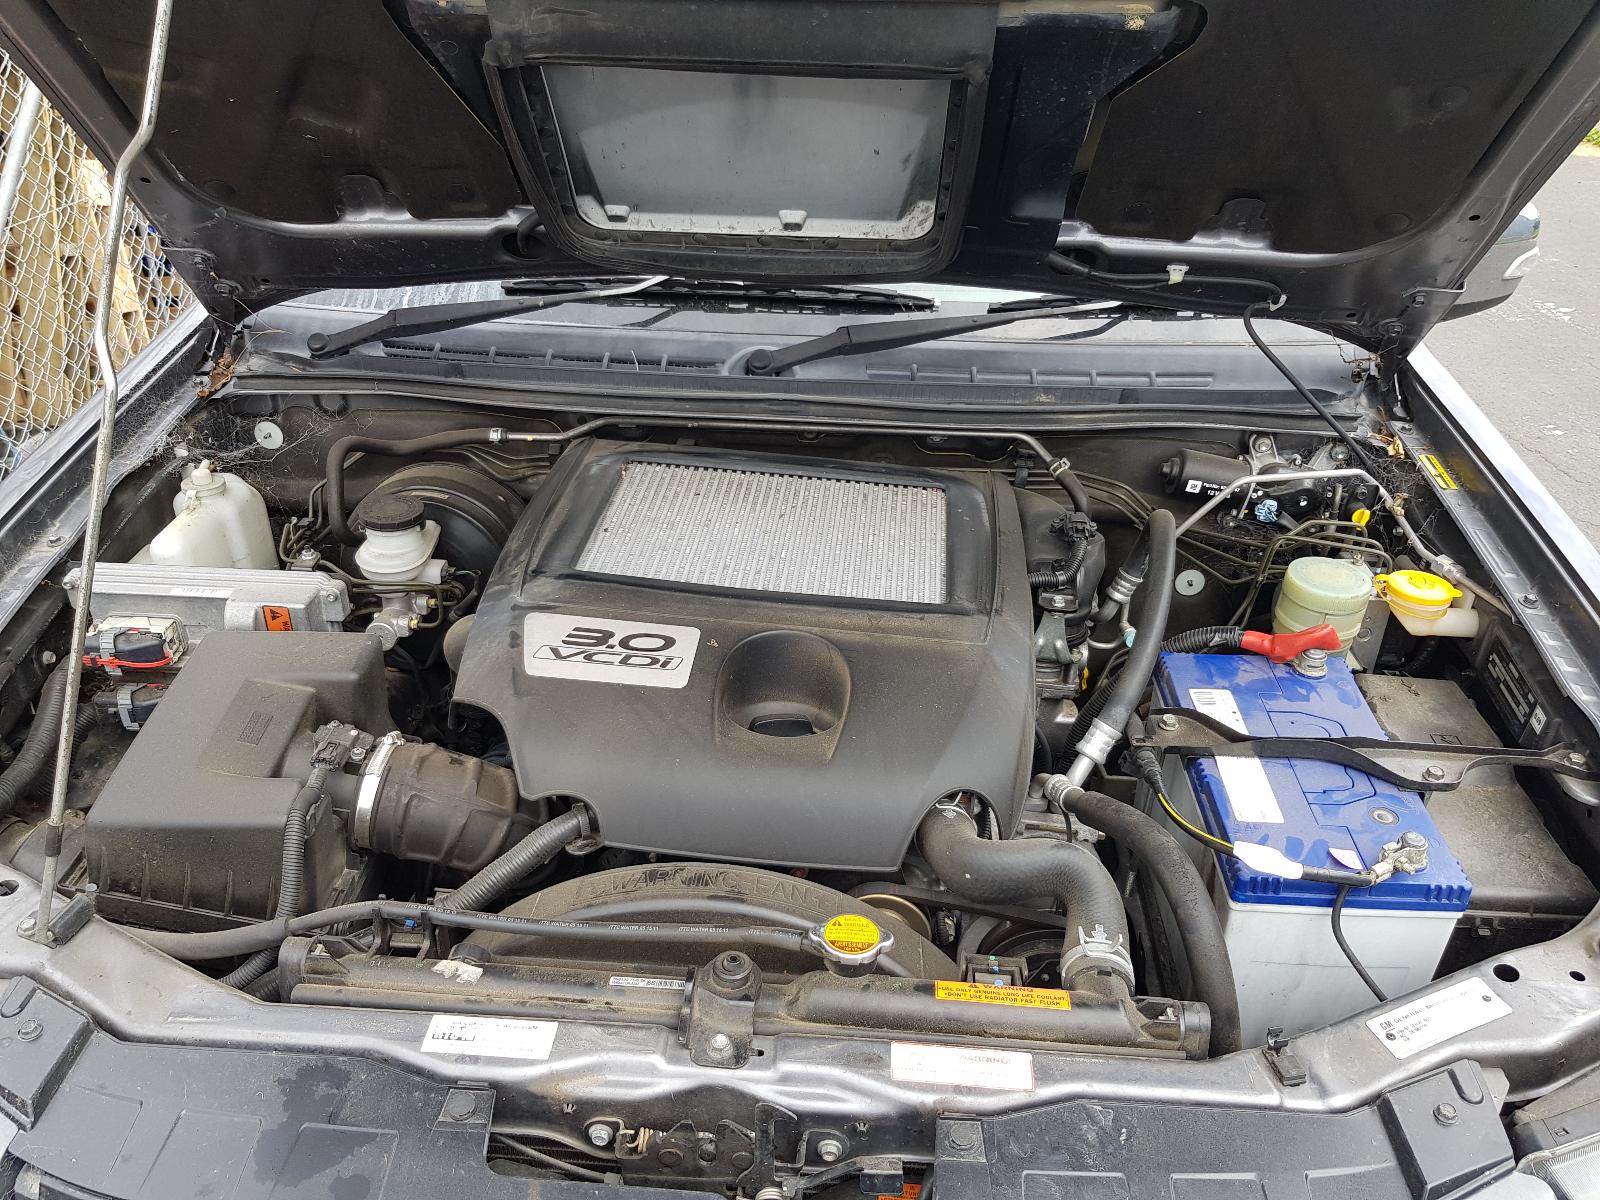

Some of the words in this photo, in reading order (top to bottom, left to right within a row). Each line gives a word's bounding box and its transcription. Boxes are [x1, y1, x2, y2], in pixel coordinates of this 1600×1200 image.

[561, 626, 677, 653] 3.0
[549, 646, 674, 669] VCDi
[983, 984, 1034, 993] WARNING
[984, 995, 1018, 1003] RADIATOR
